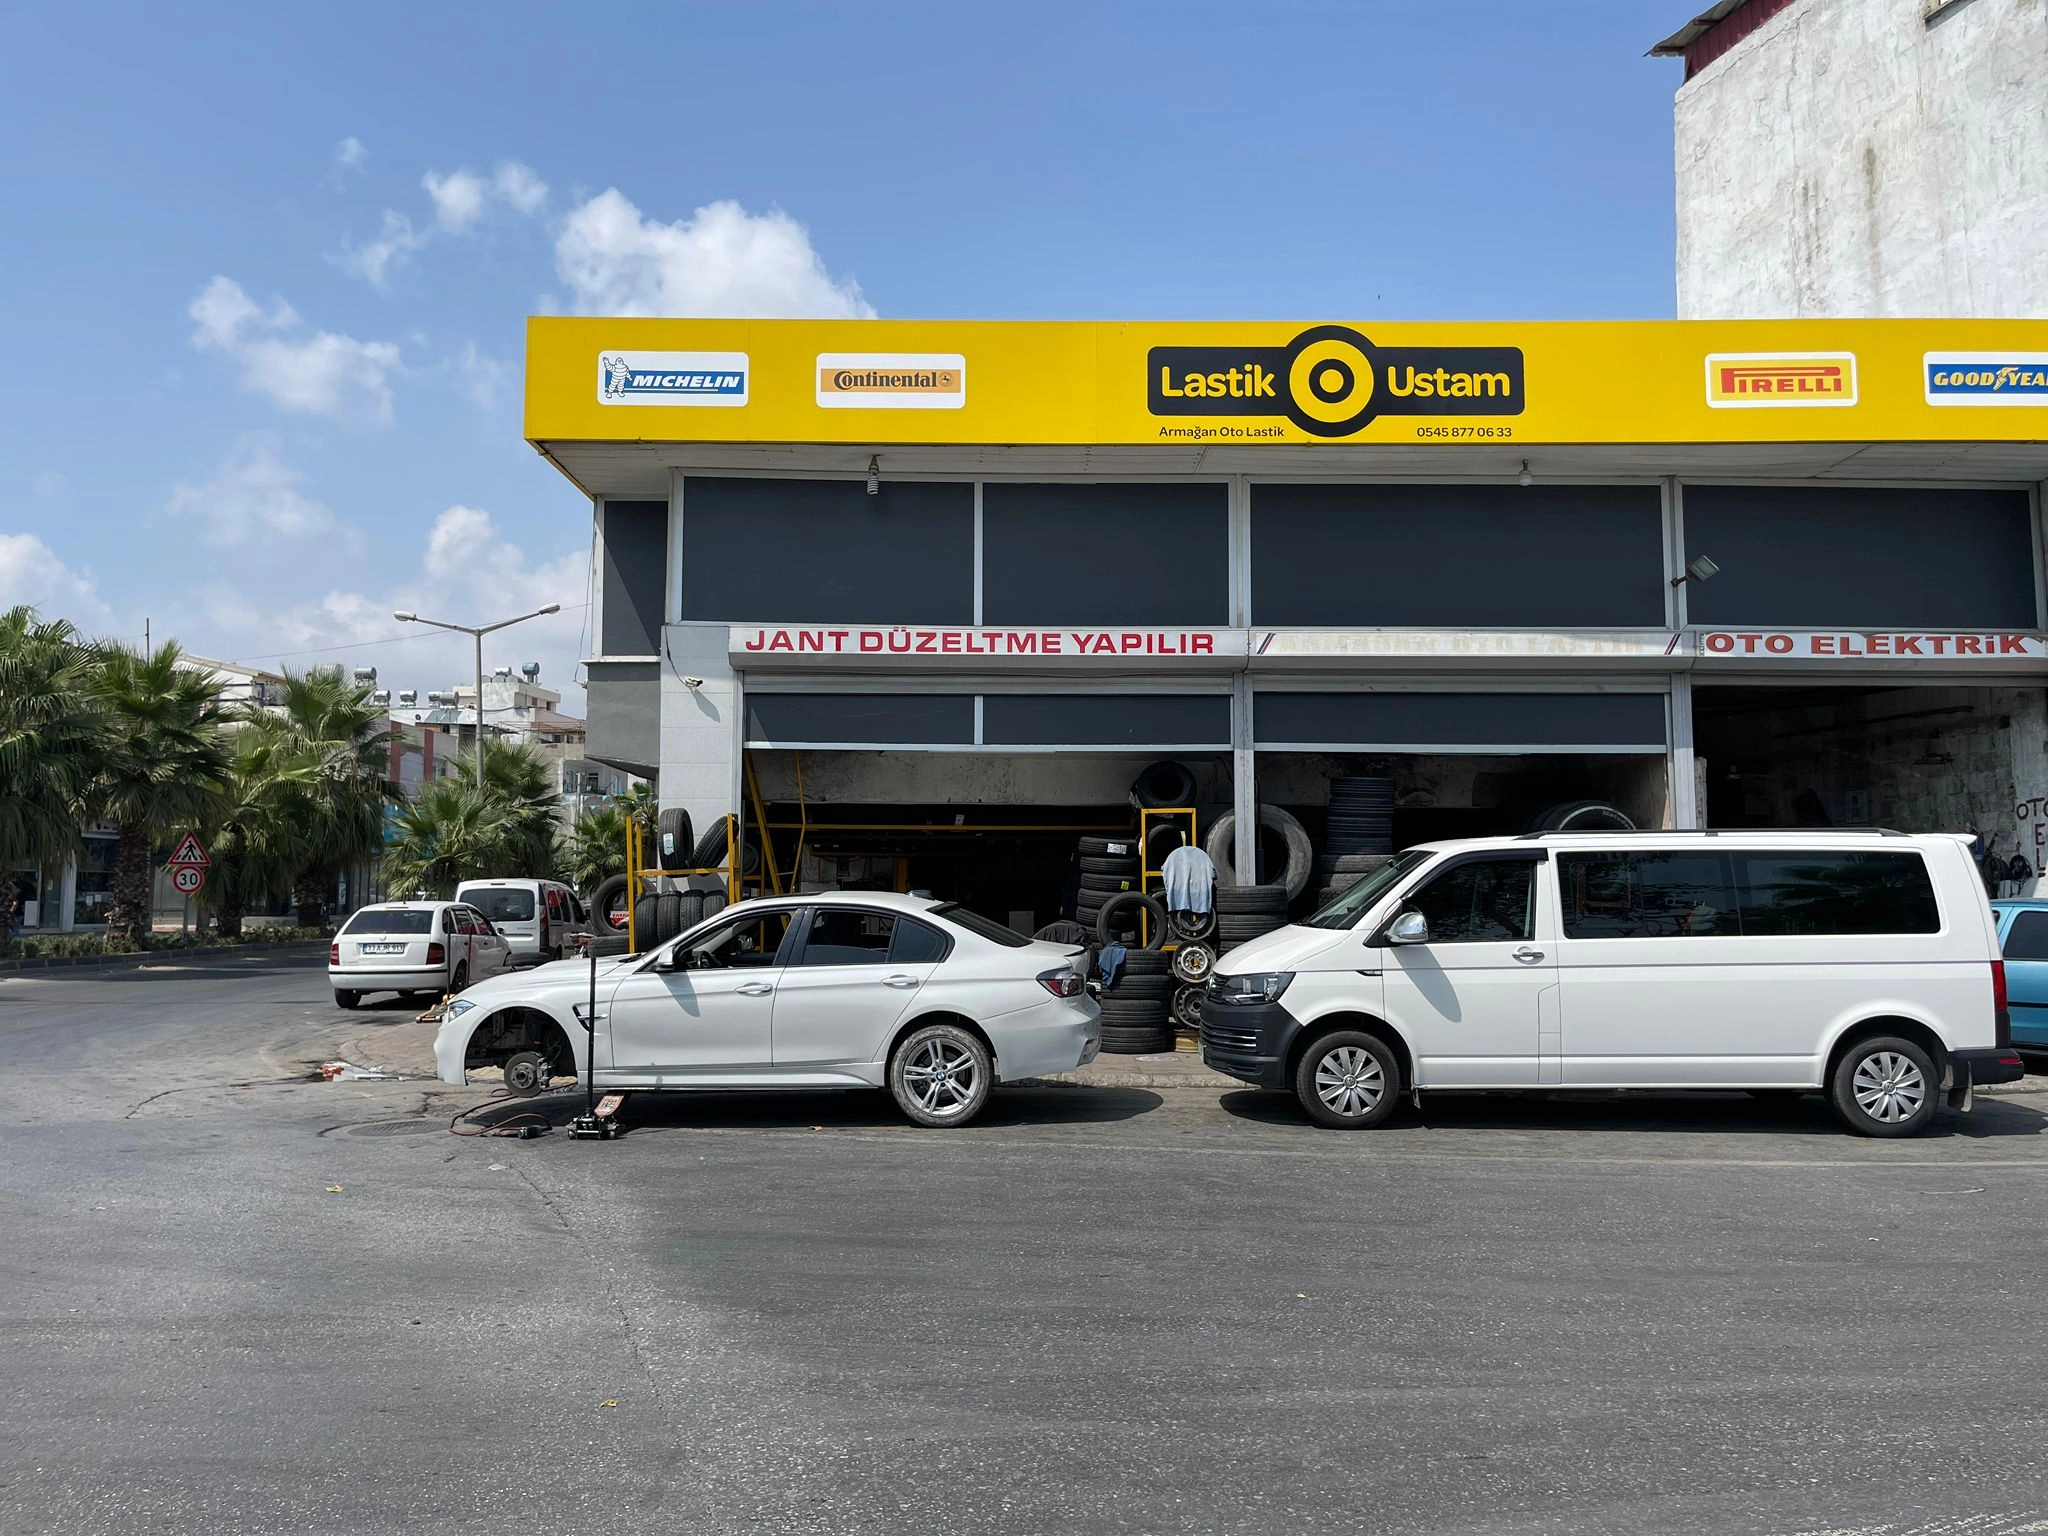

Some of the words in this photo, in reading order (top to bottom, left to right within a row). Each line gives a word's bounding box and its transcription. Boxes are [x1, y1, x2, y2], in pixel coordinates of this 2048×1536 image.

[632, 375, 740, 388] MICHELIN
[834, 371, 937, 390] Continental
[1161, 363, 1276, 398] Lastik
[1387, 366, 1511, 397] Ustam
[1720, 366, 1842, 393] PIRELLI
[1159, 426, 1217, 439] Armağan
[1220, 427, 1243, 437] Oto
[1246, 426, 1284, 437] Lastik
[1416, 427, 1449, 437] 0545
[1451, 427, 1474, 437] 877
[1477, 427, 1494, 437] 06
[1496, 427, 1512, 437] 33
[745, 630, 849, 651] JANT
[859, 626, 1061, 653] DÜZELTME
[1071, 633, 1214, 654] YAPILIR
[1705, 633, 1793, 653] OTO
[179, 873, 198, 886] 30
